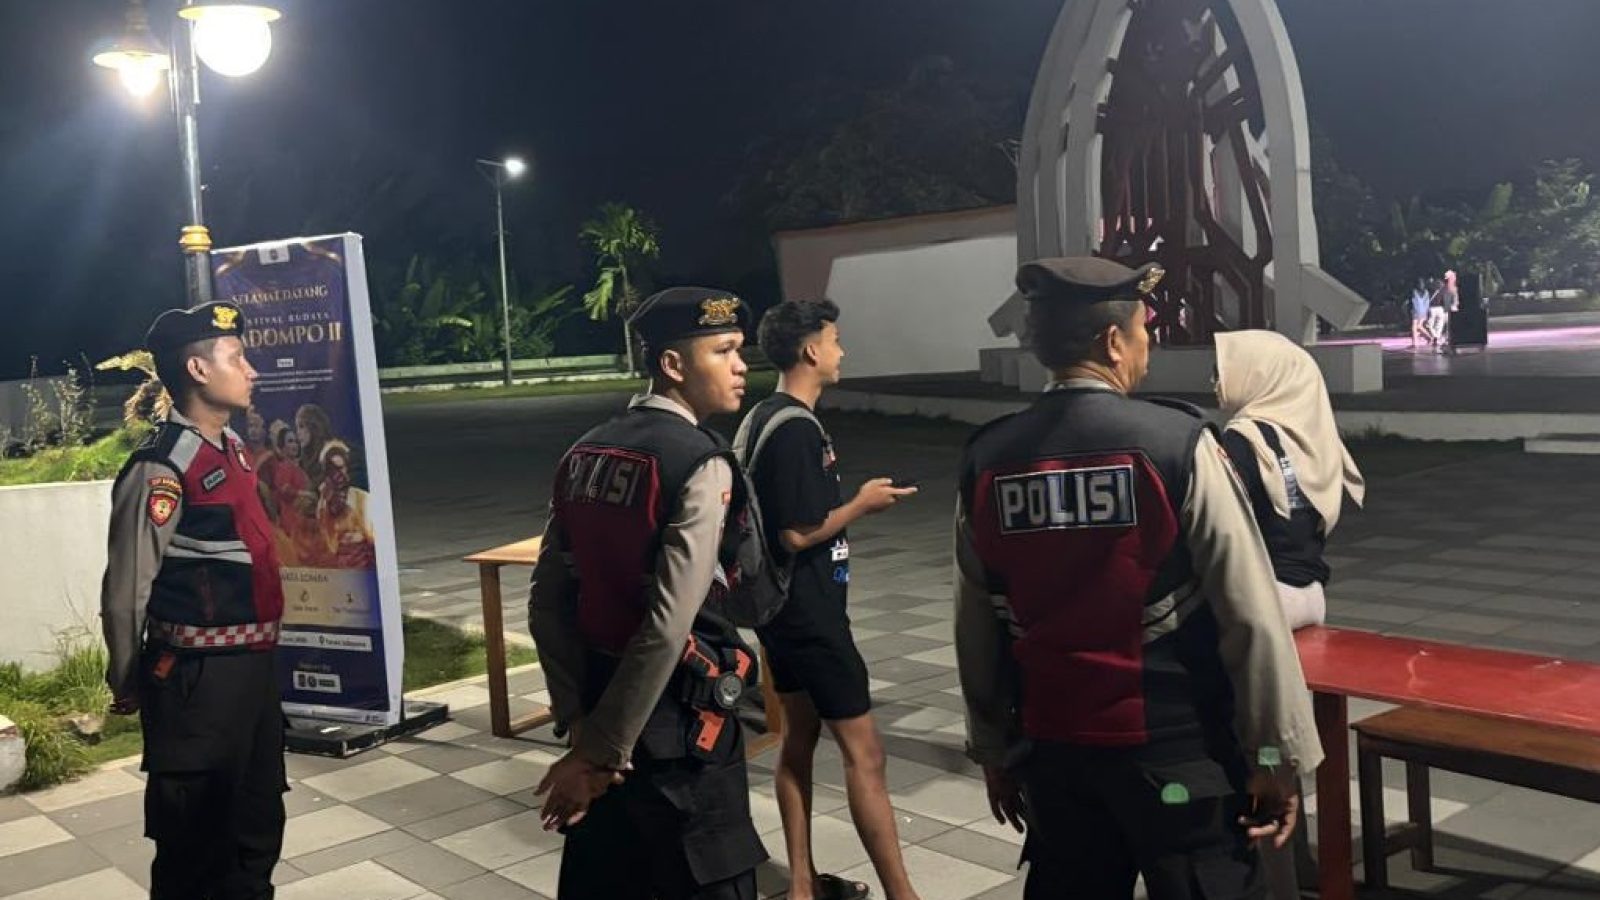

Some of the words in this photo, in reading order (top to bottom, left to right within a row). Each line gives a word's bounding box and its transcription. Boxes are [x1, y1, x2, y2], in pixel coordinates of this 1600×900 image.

[232, 290, 279, 304] SELAMAT
[283, 285, 328, 299] DATANG
[241, 324, 324, 348] ADOMPO
[329, 322, 341, 341] II
[1001, 471, 1131, 527] POLISI
